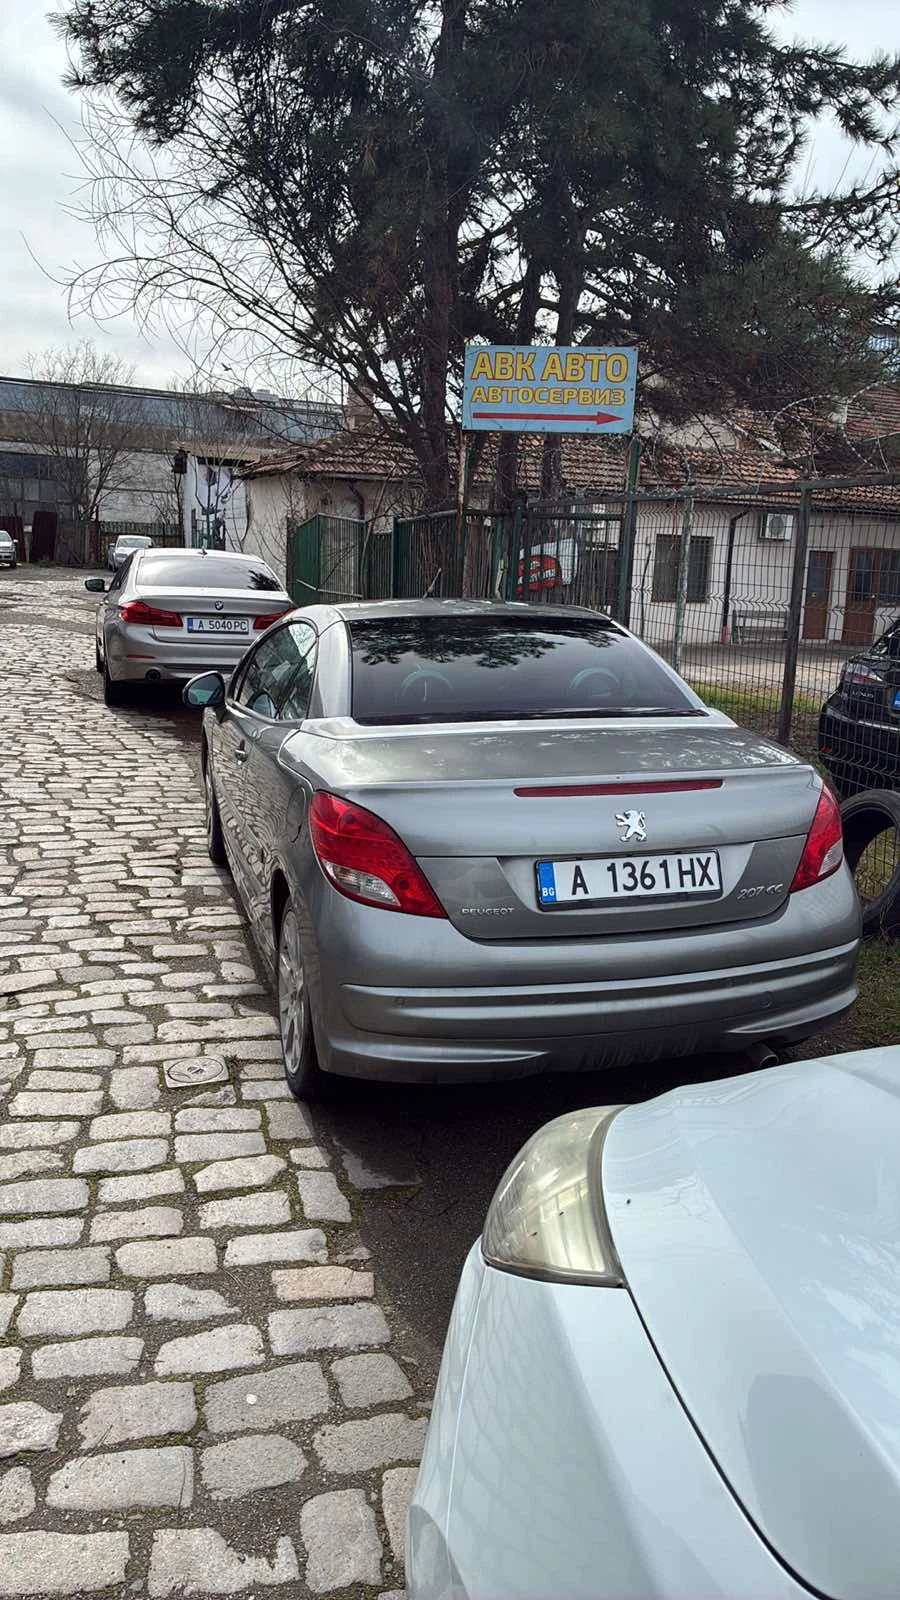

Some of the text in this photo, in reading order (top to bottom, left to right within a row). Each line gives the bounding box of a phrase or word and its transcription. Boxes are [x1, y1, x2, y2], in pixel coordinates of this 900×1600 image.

[471, 352, 629, 383] АВК АВТО
[471, 386, 625, 406] АВТОСЕРВИЗ
[571, 864, 590, 896] A
[542, 887, 555, 897] BG
[737, 885, 766, 900] 207
[461, 907, 516, 915] PEUGEOT
